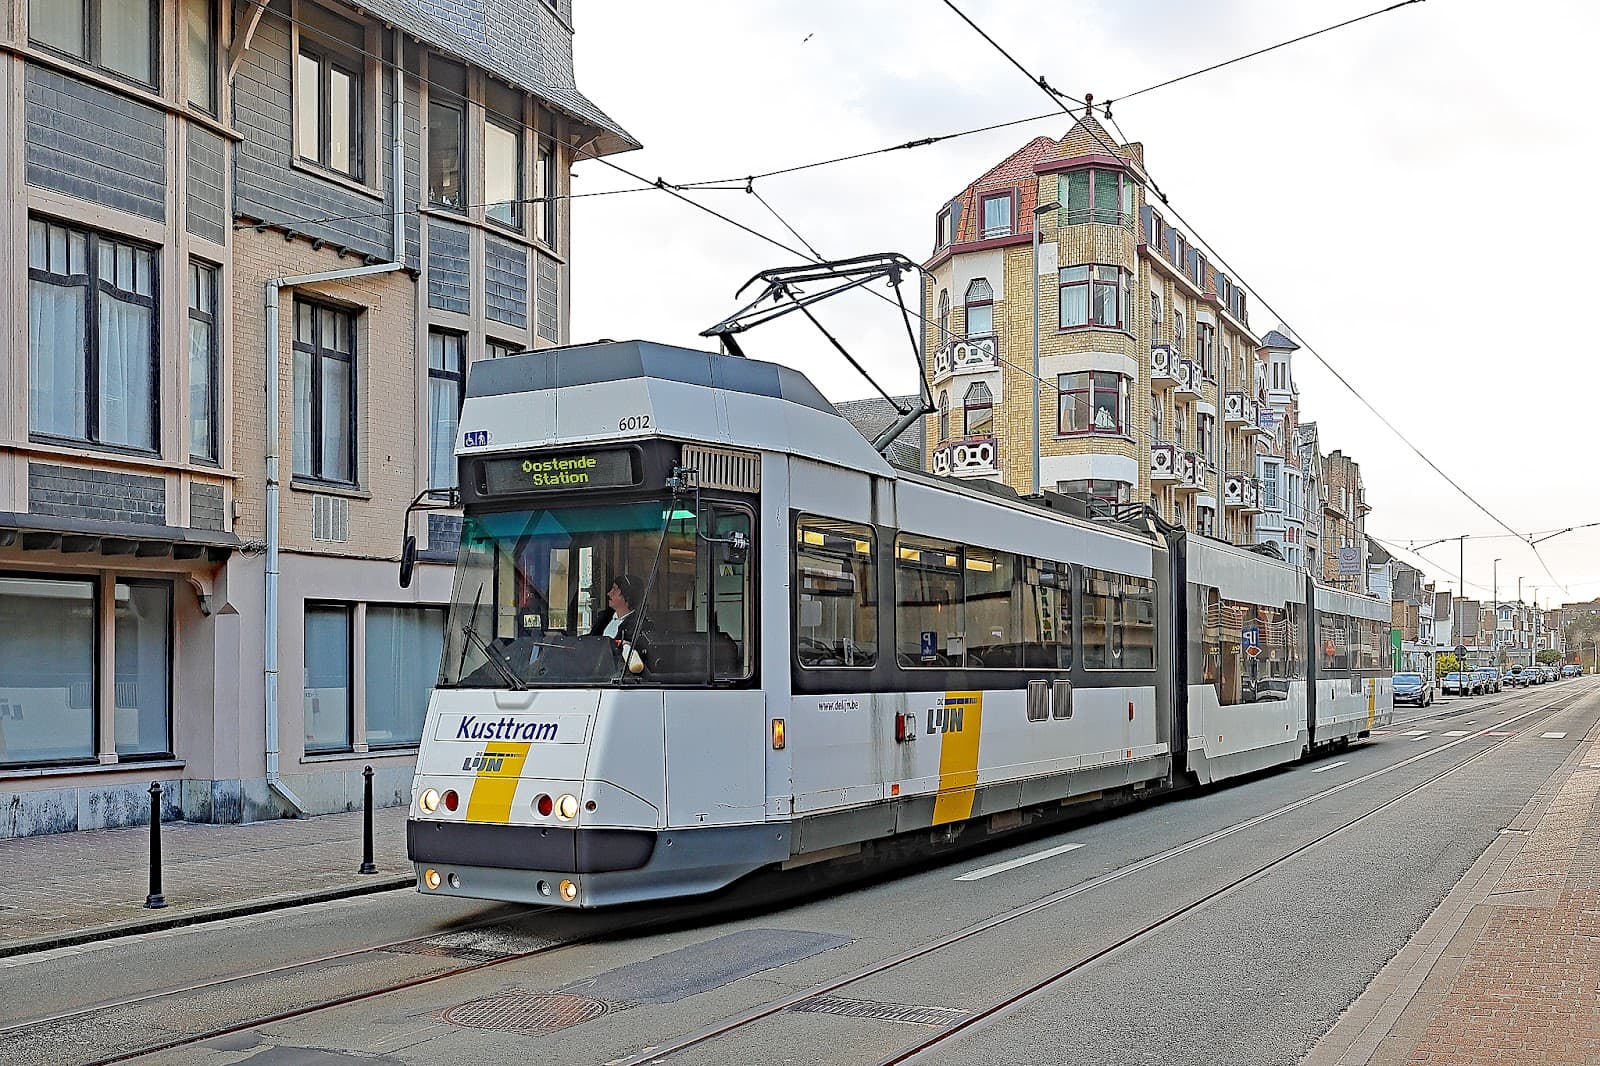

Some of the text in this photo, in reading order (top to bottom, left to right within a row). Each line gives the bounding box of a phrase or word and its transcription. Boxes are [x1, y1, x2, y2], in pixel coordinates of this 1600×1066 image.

[619, 415, 650, 431] 6012
[522, 456, 597, 473] Oostende
[533, 471, 589, 486] Station
[818, 699, 859, 713] www.delijn.be
[456, 715, 559, 741] Kusttram
[926, 707, 964, 735] LIJN
[462, 757, 503, 772] LIJN
